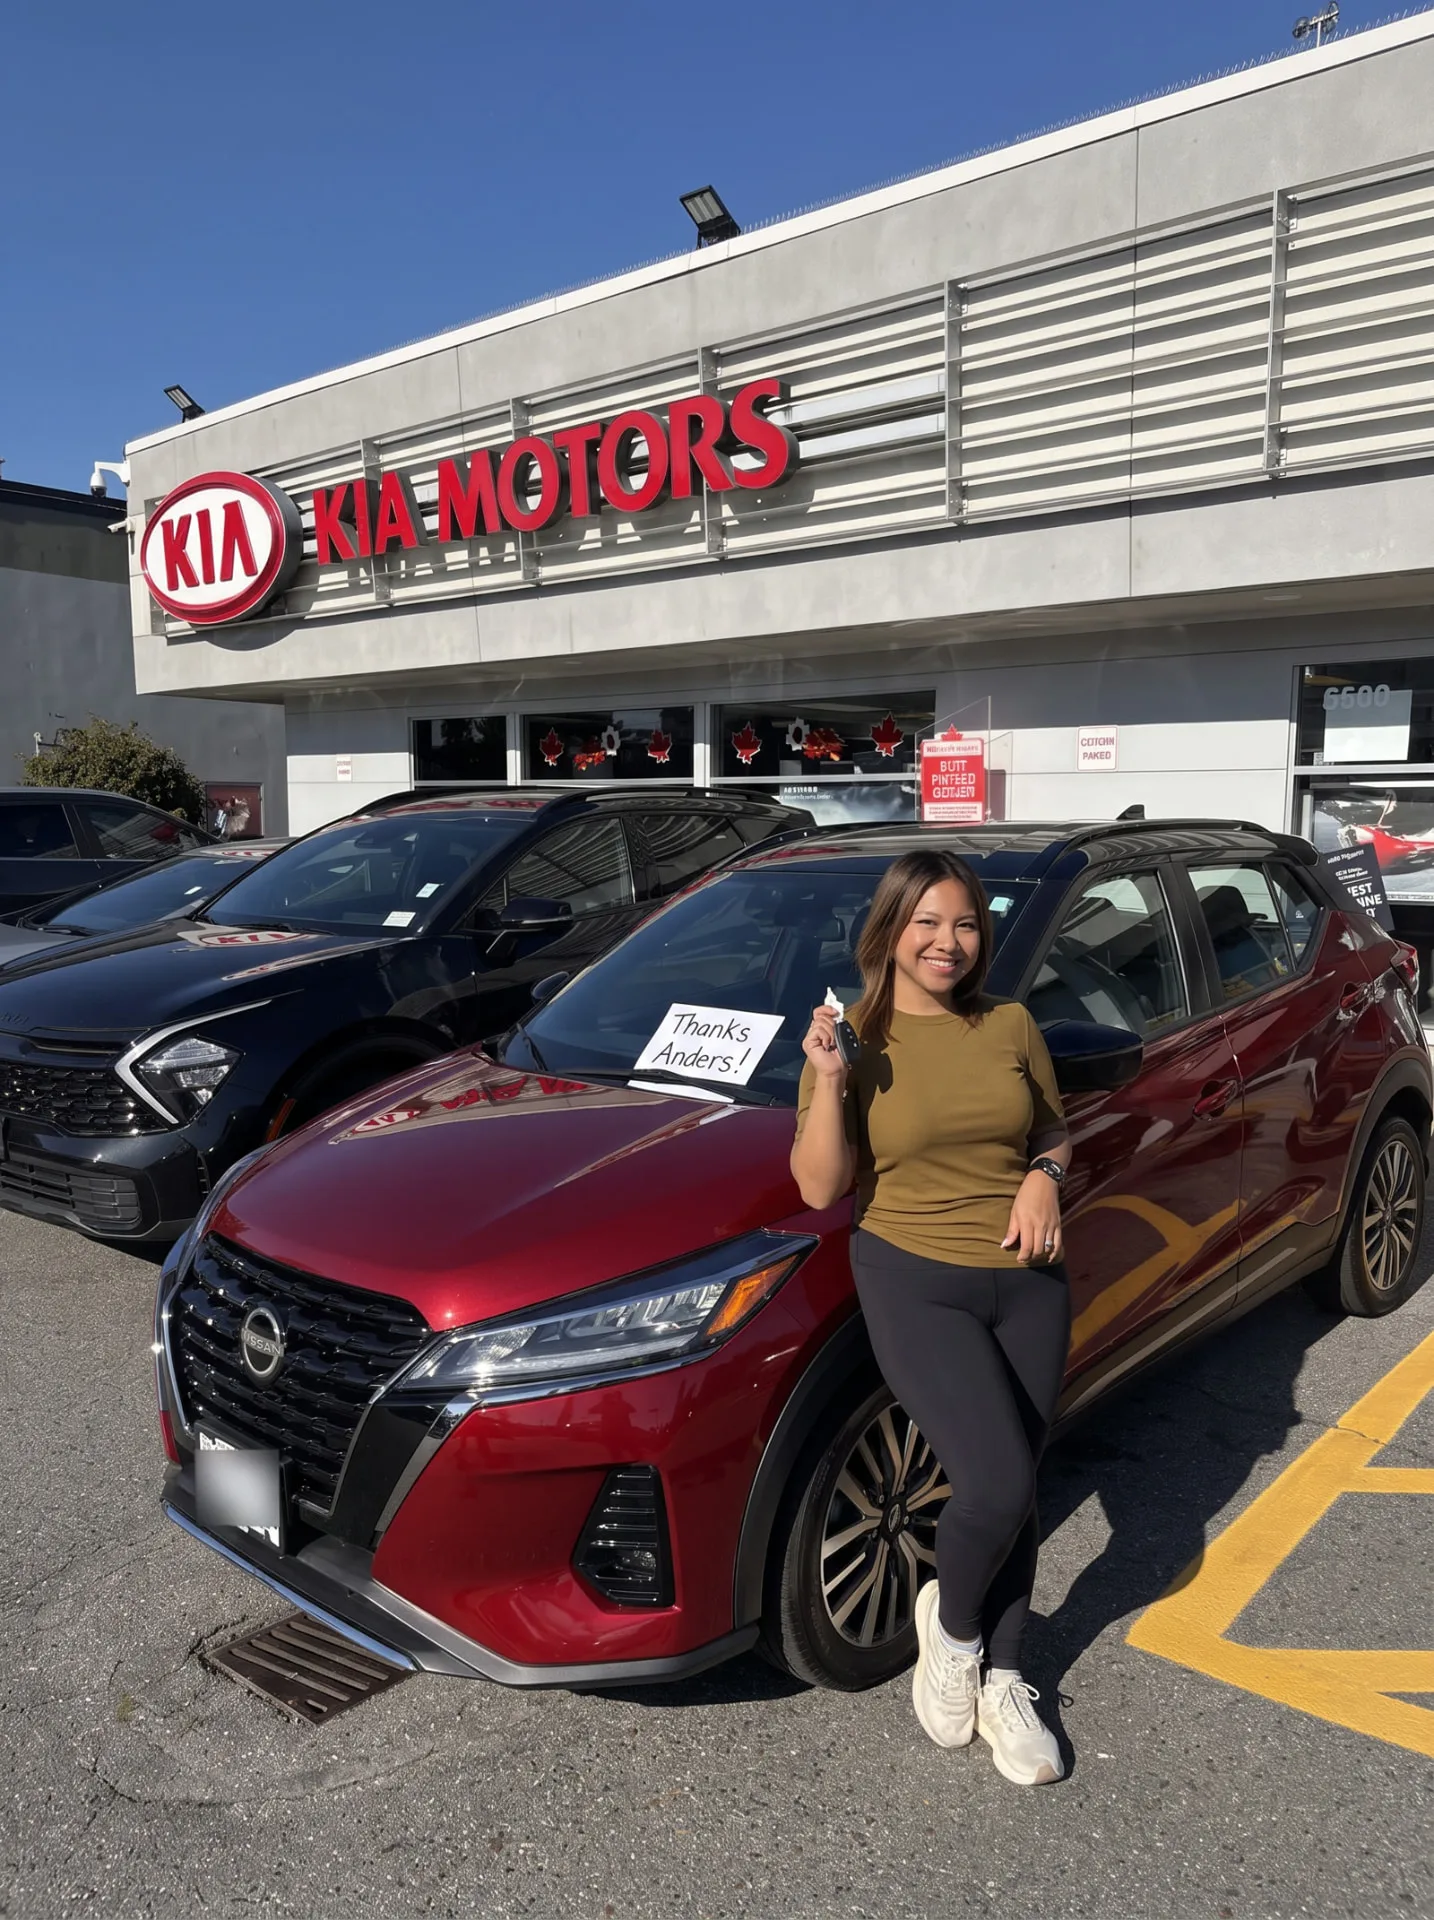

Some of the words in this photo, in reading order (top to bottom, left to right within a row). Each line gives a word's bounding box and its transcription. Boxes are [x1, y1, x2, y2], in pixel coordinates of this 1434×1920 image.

[313, 471, 420, 565] KIA
[438, 378, 789, 543] MOTORS
[161, 500, 258, 592] KIA
[651, 1041, 752, 1074] Anders!
[673, 1013, 751, 1043] Thanks
